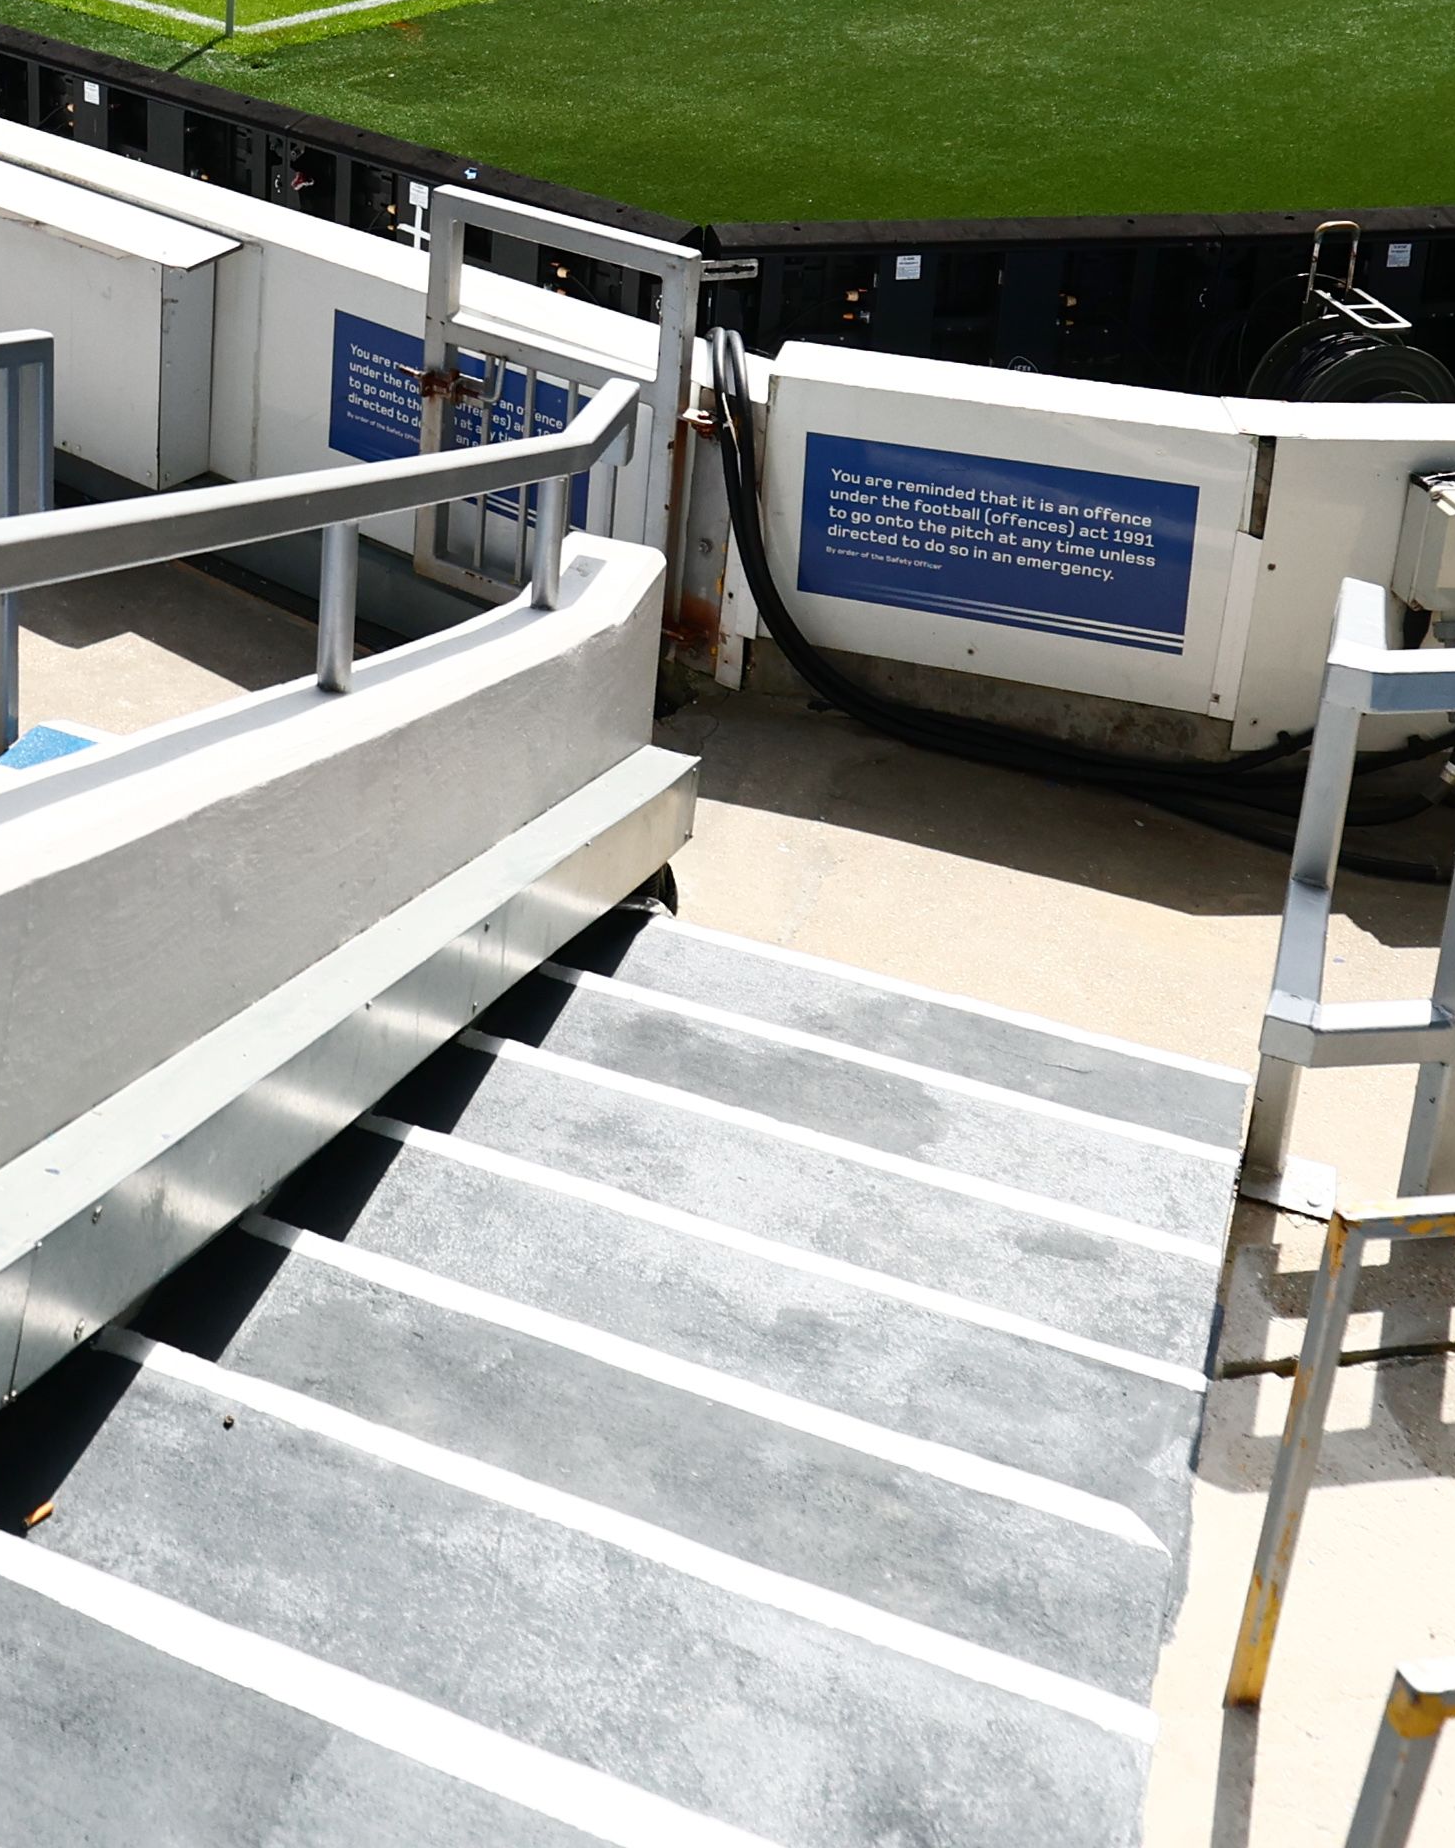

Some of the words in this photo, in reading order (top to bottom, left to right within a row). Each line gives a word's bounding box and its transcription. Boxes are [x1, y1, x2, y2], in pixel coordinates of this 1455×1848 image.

[349, 362, 381, 379] under
[383, 372, 402, 388] the
[349, 375, 361, 389] to
[363, 382, 377, 395] go
[379, 388, 405, 405] onto
[460, 418, 473, 431] at
[350, 343, 370, 360] You
[372, 353, 390, 367] are
[499, 400, 514, 412] an
[348, 392, 394, 418] directed
[396, 410, 409, 423] to
[830, 489, 879, 505] under
[882, 494, 911, 511] the
[914, 499, 980, 521] football
[984, 507, 1075, 538] (offences)
[1079, 526, 1109, 541] act
[1113, 529, 1155, 548] 1991
[831, 468, 861, 485] You
[865, 476, 893, 489] are
[897, 481, 976, 501] reminded
[980, 490, 1018, 508] that
[1022, 495, 1036, 510] it
[1039, 498, 1054, 513] is
[1058, 504, 1079, 517] an
[1083, 506, 1152, 528] offence
[826, 545, 836, 554] By
[837, 548, 860, 557] order
[871, 553, 885, 561] the
[886, 555, 913, 567] Safety
[913, 559, 943, 570] Officer
[827, 524, 898, 546] directed
[902, 535, 920, 549] to
[924, 538, 945, 553] do
[949, 544, 970, 557] so
[973, 545, 987, 560] in
[992, 551, 1012, 563] an
[1016, 555, 1114, 582] emergency.
[828, 505, 847, 520] to
[851, 511, 871, 524] go
[875, 514, 914, 530] onto
[918, 518, 947, 534] the
[950, 525, 994, 542] pitch
[998, 531, 1018, 546] at
[1021, 537, 1052, 553] any
[1056, 539, 1095, 558] time
[1099, 549, 1156, 567] unless
